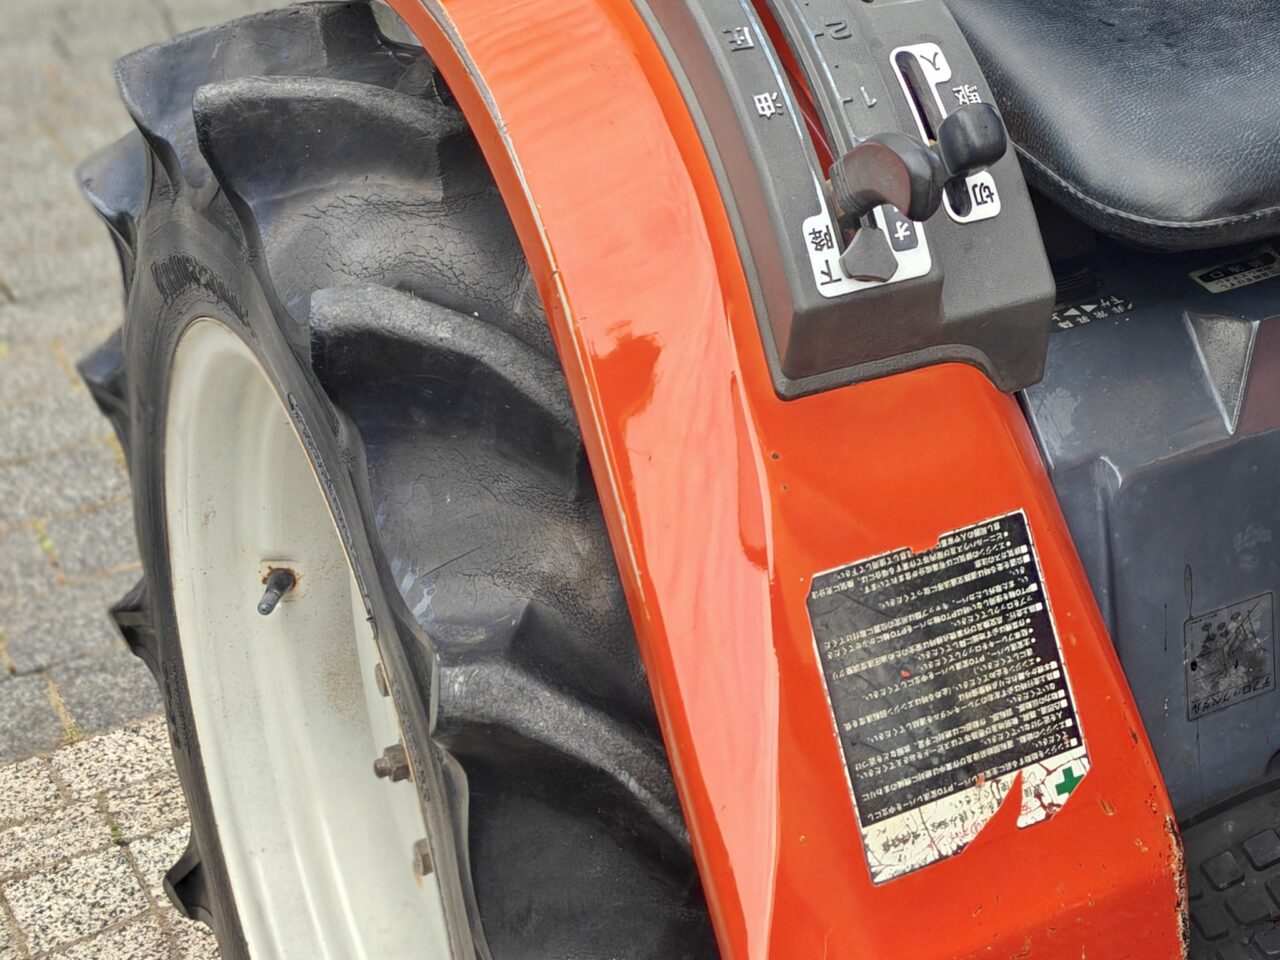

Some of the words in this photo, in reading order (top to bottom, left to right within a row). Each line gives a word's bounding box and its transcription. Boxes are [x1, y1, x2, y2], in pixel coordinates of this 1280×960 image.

[824, 20, 853, 41] 2
[919, 51, 942, 72] 入
[859, 85, 878, 110] 1
[970, 183, 995, 209] 切
[808, 225, 842, 286] 下降
